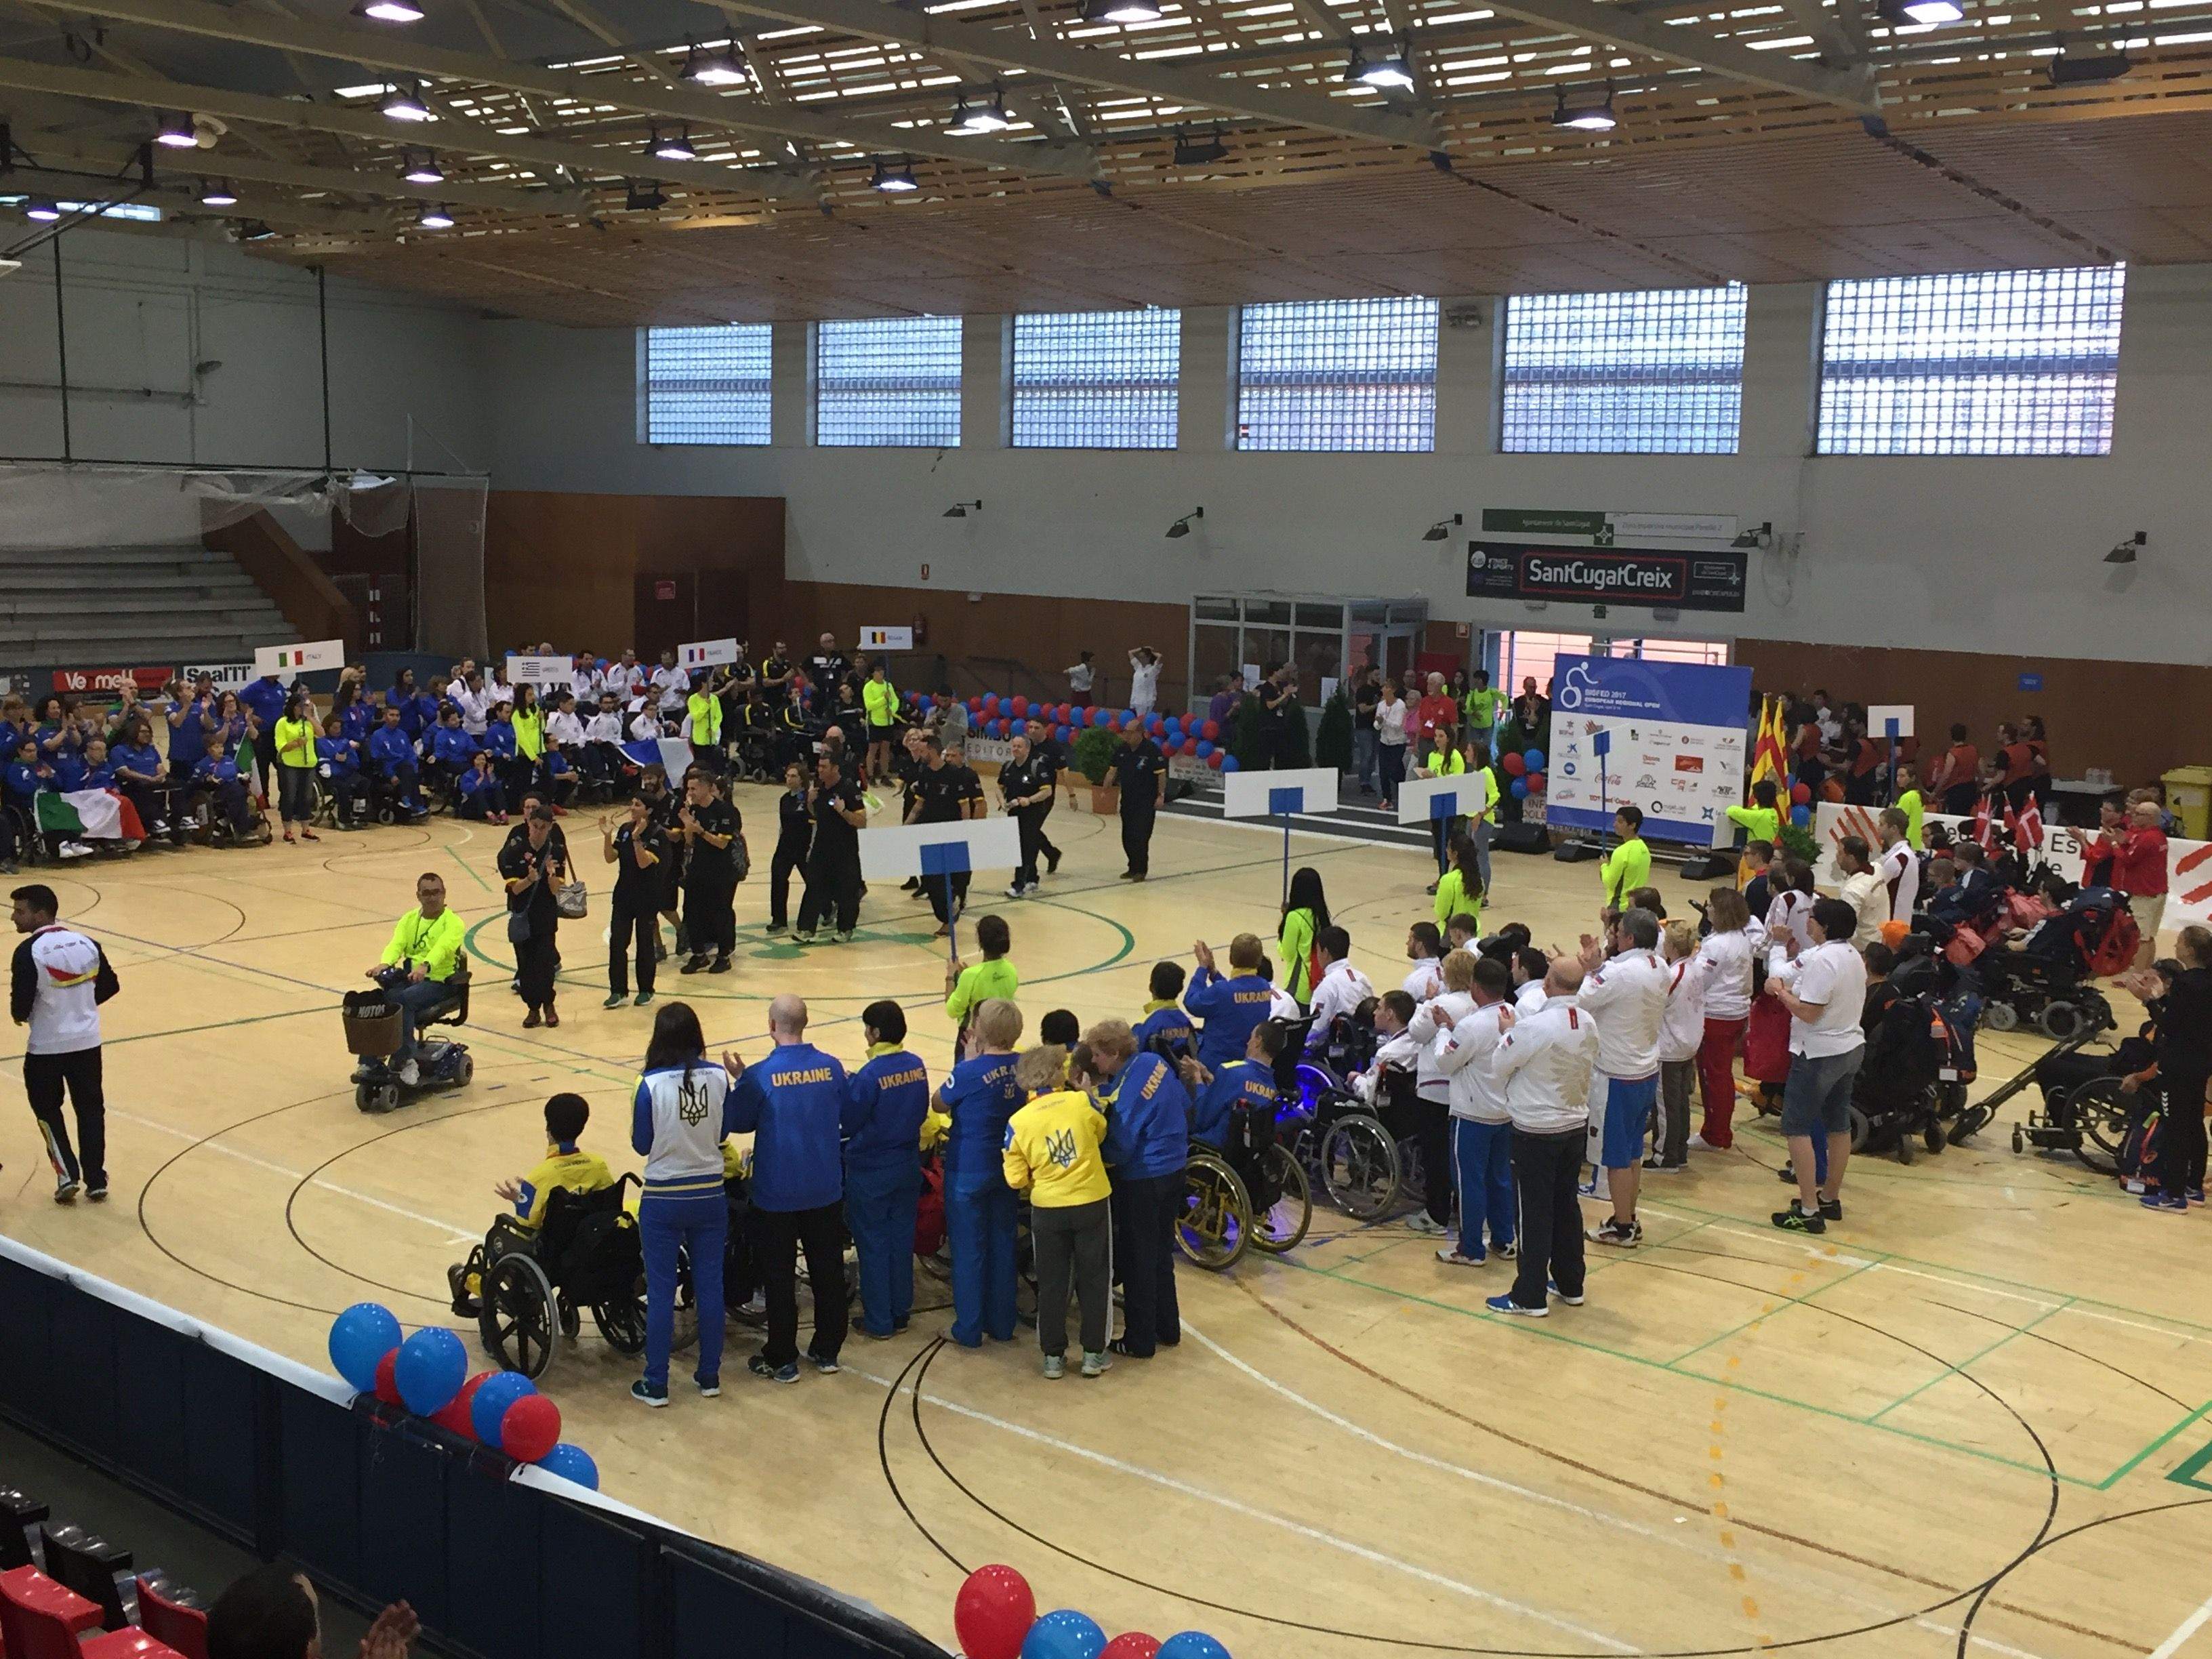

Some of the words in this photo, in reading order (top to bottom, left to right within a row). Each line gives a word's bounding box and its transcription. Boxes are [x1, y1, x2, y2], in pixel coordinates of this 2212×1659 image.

[1529, 559, 1673, 590] SantCugatCreix
[1611, 691, 1626, 699] 2017
[771, 1067, 833, 1087] UKRAINE
[878, 1067, 926, 1090] UKRAINE
